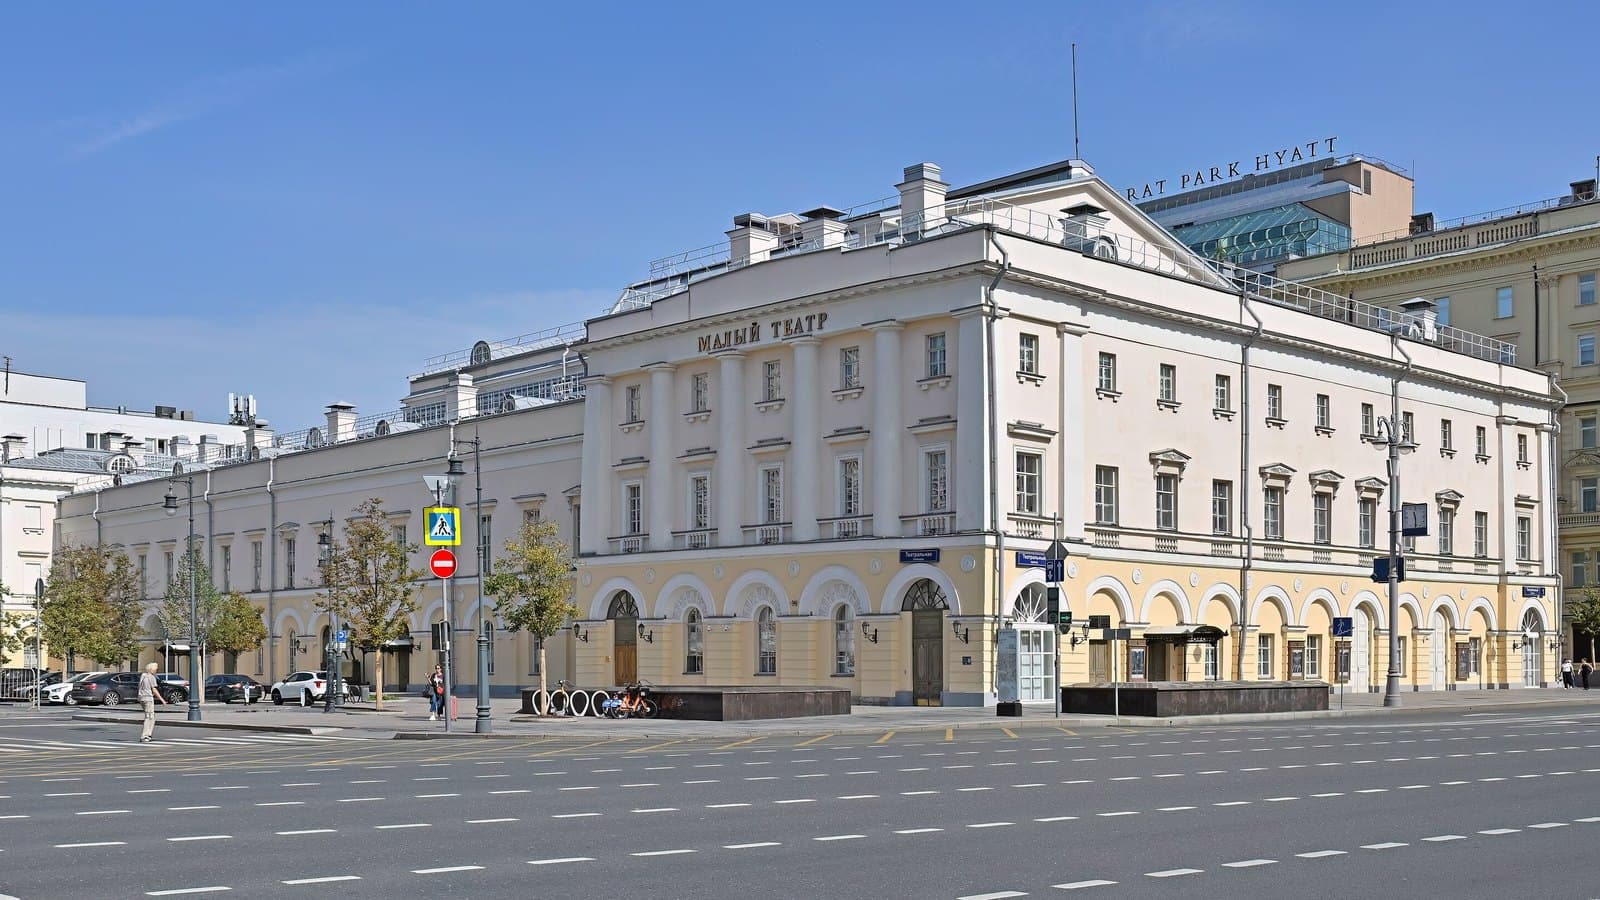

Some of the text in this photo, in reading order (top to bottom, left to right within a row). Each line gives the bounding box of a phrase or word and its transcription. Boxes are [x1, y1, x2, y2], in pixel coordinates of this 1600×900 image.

[1181, 161, 1240, 189] PARK
[1256, 136, 1338, 171] HYATT
[698, 312, 828, 352] МАЛЫЙ ТЕАТР
